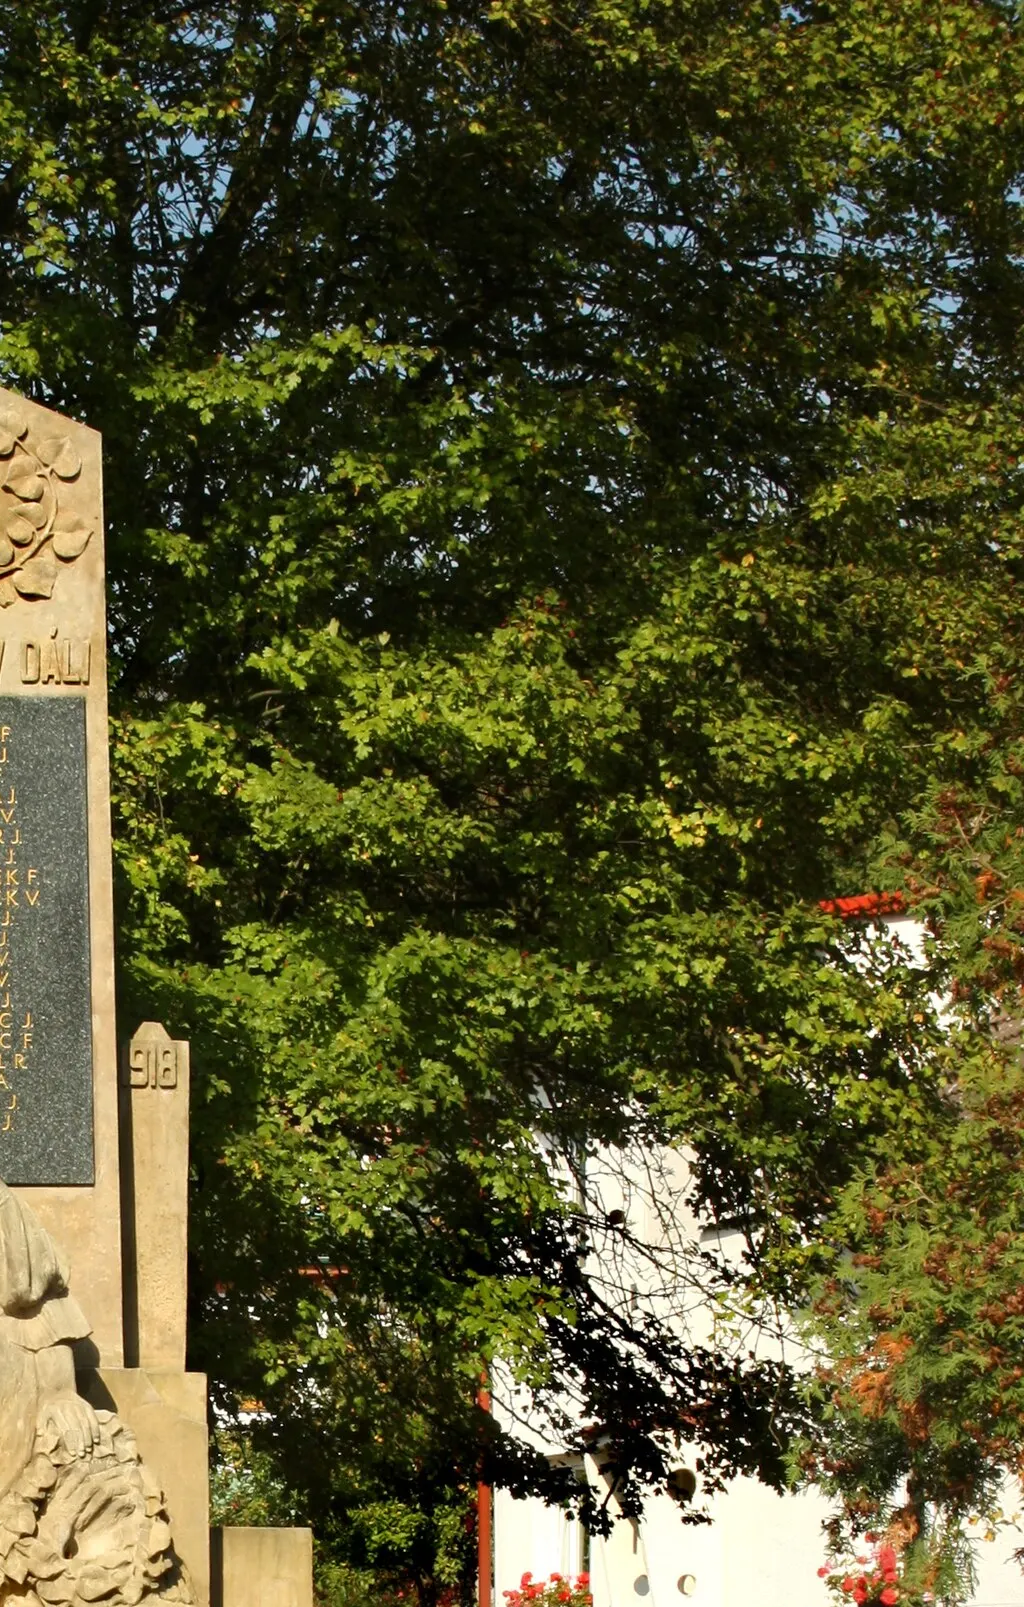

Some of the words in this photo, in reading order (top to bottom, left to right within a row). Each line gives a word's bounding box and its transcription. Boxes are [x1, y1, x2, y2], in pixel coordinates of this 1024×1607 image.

[20, 626, 92, 686] DÁLI
[0, 726, 13, 743] F.
[0, 747, 9, 763] J.
[7, 788, 18, 804] J.
[0, 809, 16, 824] V.
[10, 829, 22, 844] J.
[25, 891, 41, 906] V.
[22, 1012, 34, 1028] J.
[23, 1033, 34, 1049] F.
